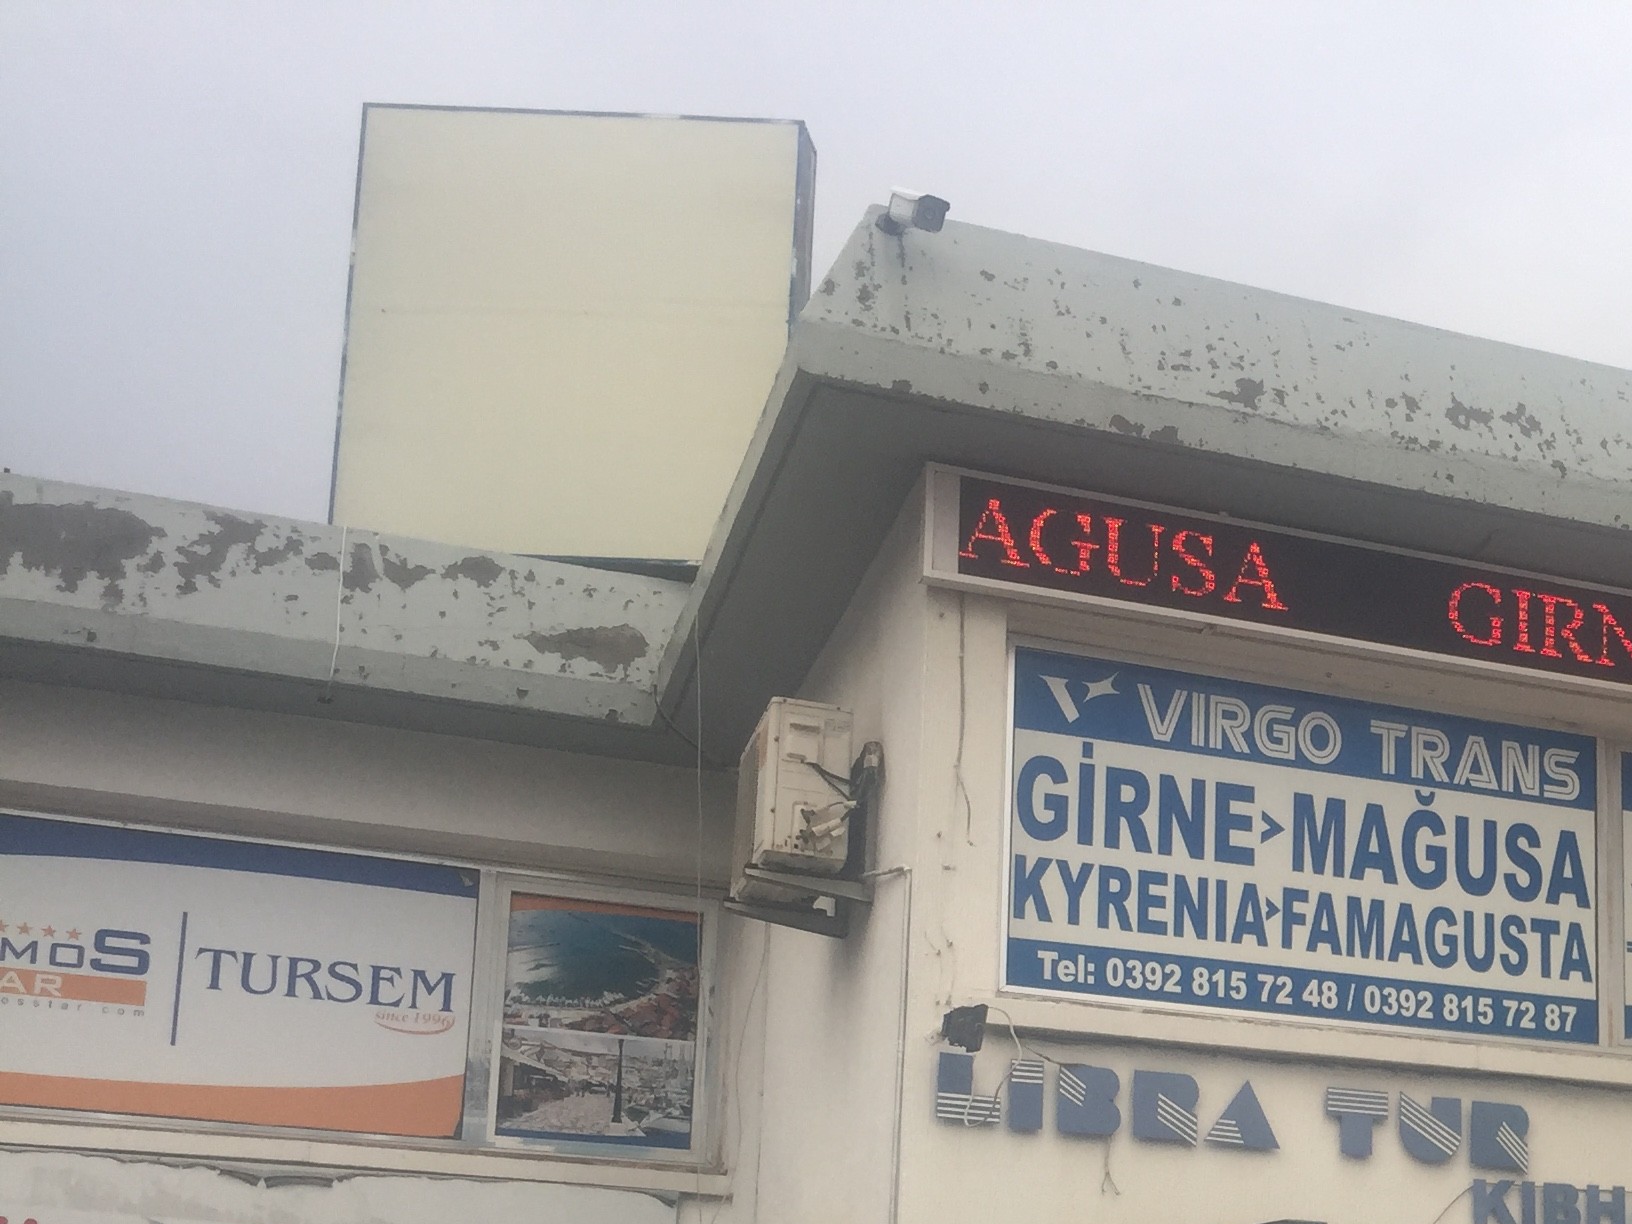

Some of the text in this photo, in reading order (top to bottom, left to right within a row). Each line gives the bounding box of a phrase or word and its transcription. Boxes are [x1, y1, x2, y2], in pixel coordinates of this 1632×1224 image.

[959, 497, 1288, 611] AGUSA
[1136, 684, 1580, 801] VIRGO TRANS
[195, 946, 456, 1013] TURSEM
[1037, 950, 1094, 986] Tel:
[1105, 957, 1181, 993] 0392
[1191, 966, 1246, 1001] 815
[1256, 973, 1293, 1006] 72
[1302, 979, 1339, 1010] 48
[1363, 983, 1434, 1020] 0392
[1443, 992, 1494, 1026] 815
[1503, 998, 1537, 1030] 72
[1545, 1002, 1577, 1034] 87
[935, 1051, 1529, 1176] LIBRA TUR
